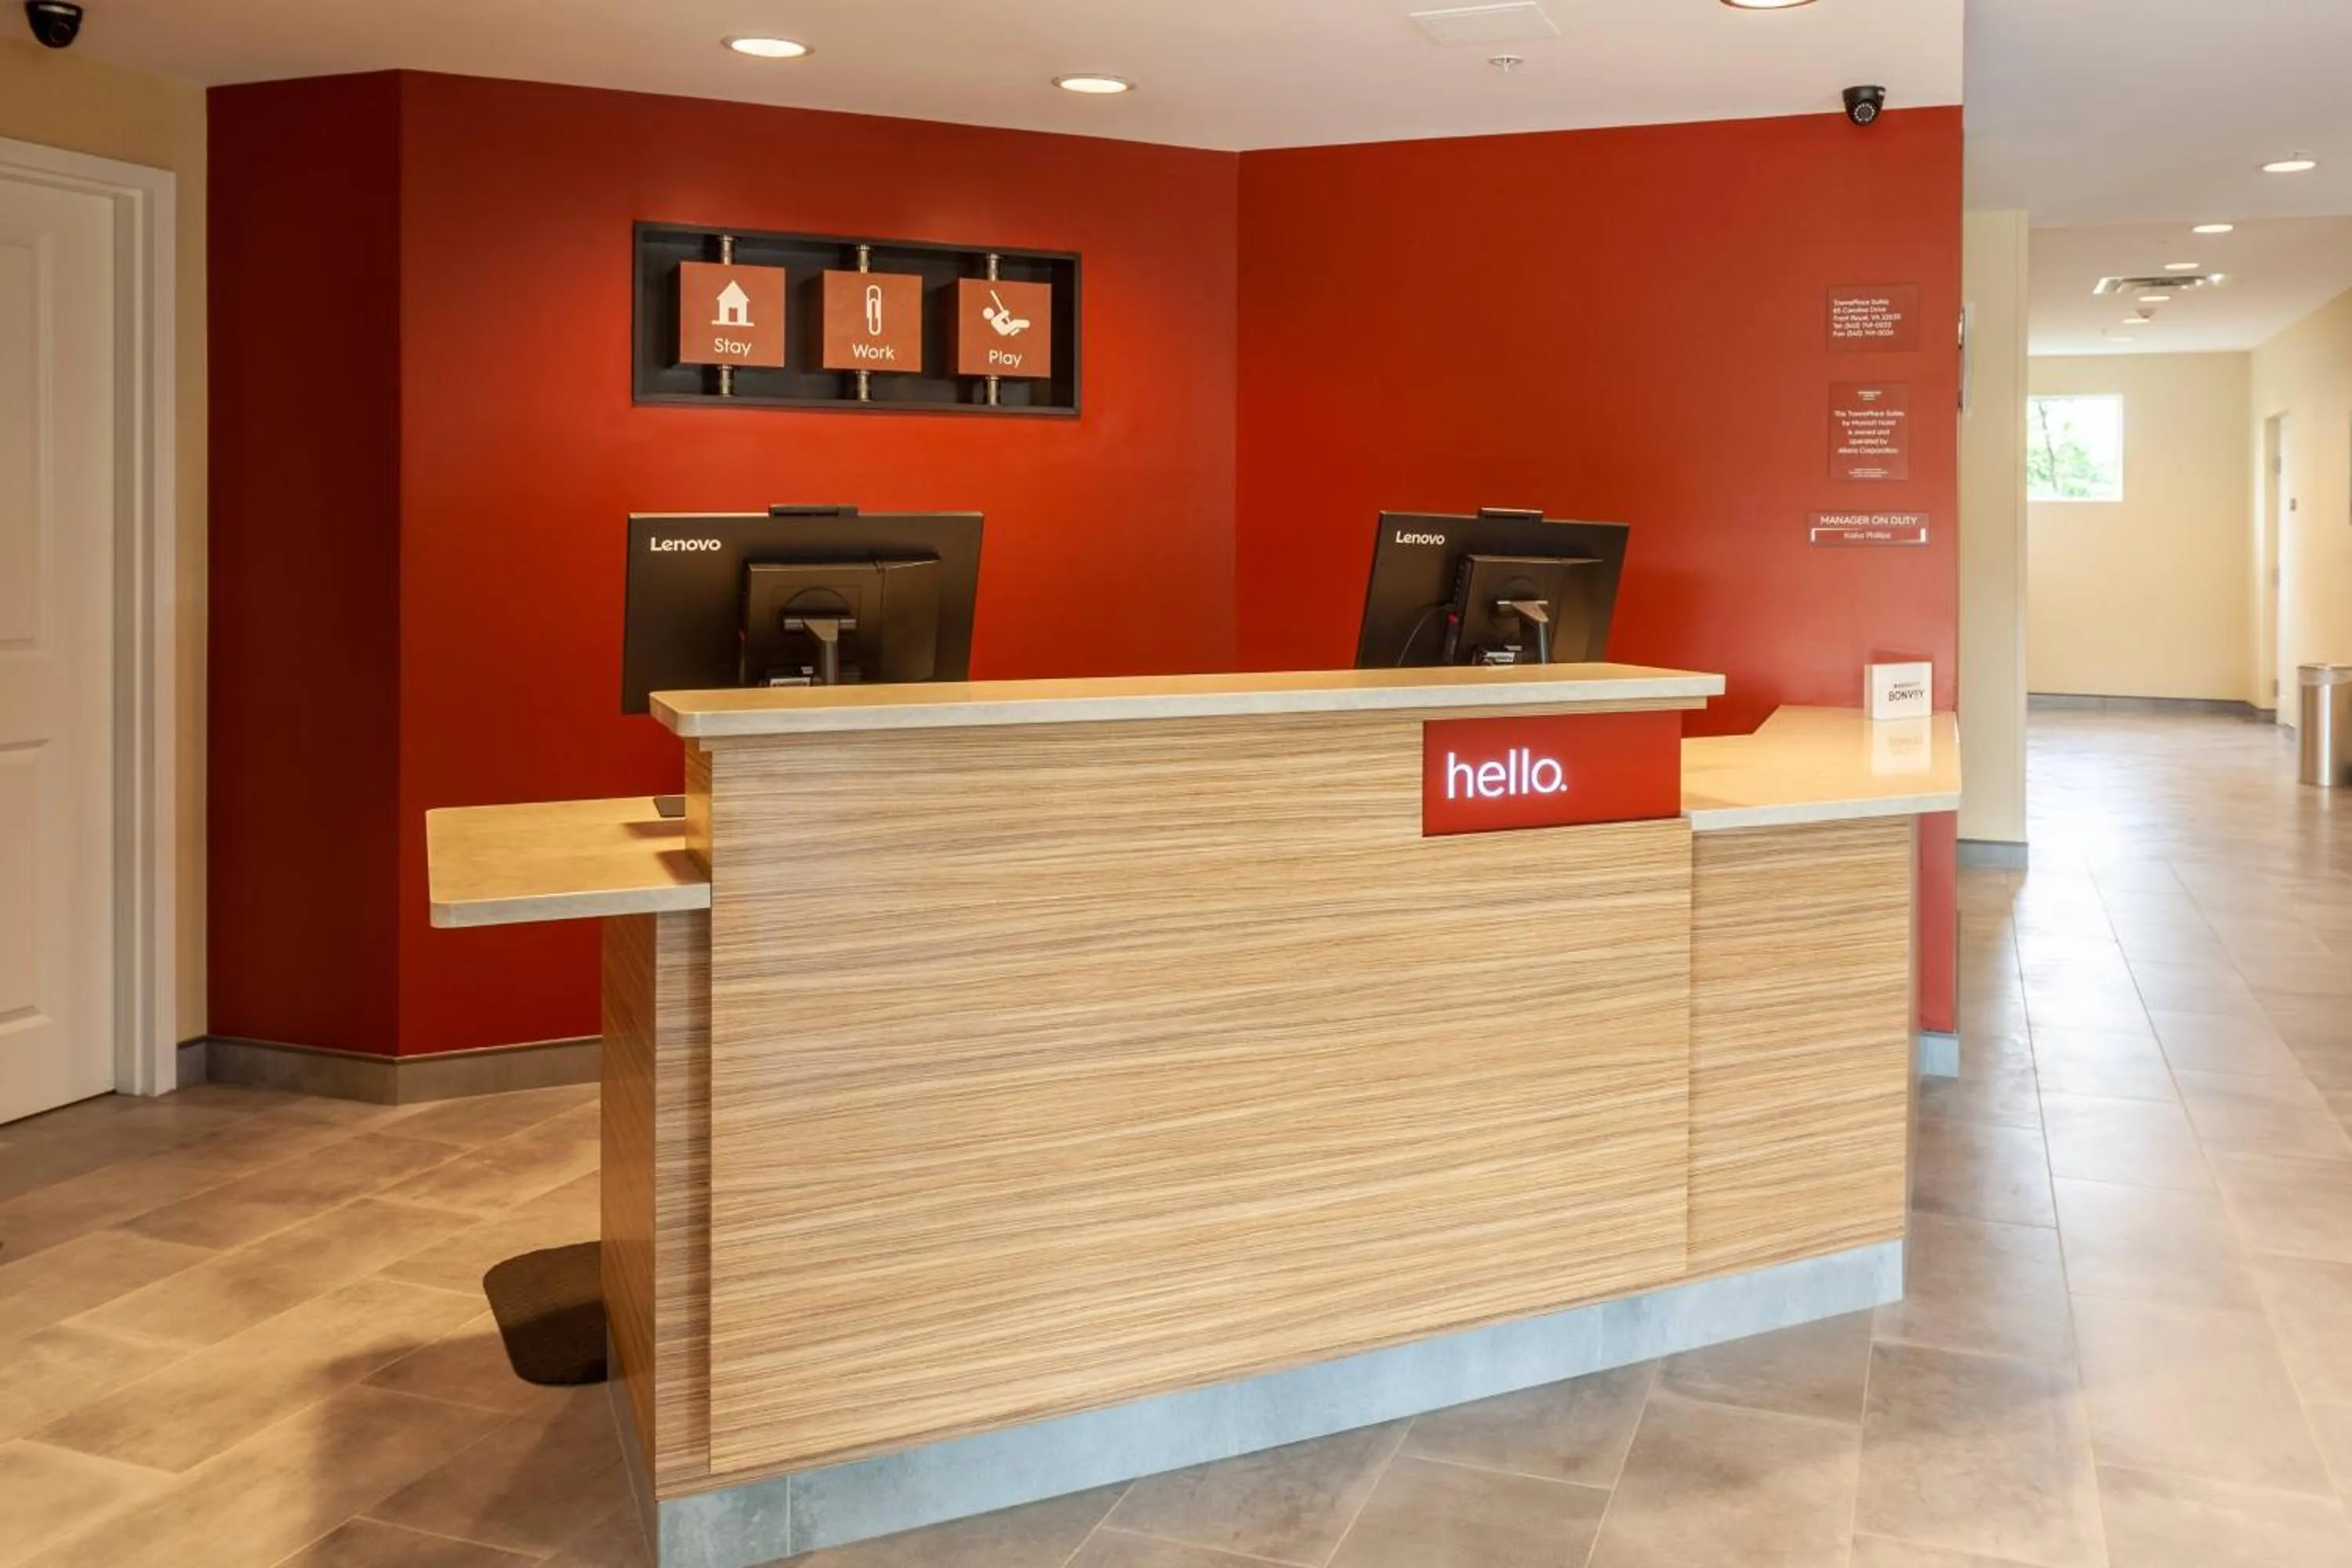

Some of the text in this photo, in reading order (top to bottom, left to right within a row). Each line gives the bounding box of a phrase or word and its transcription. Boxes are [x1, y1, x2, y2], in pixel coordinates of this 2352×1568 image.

[714, 337, 753, 357] Stay
[852, 343, 895, 361] Work
[988, 349, 1023, 367] Play
[1820, 515, 1918, 525] MANAGER ON DUTY
[650, 537, 721, 553] Lenovo
[1396, 531, 1445, 546] Lenovo
[1446, 748, 1569, 800] hello.
